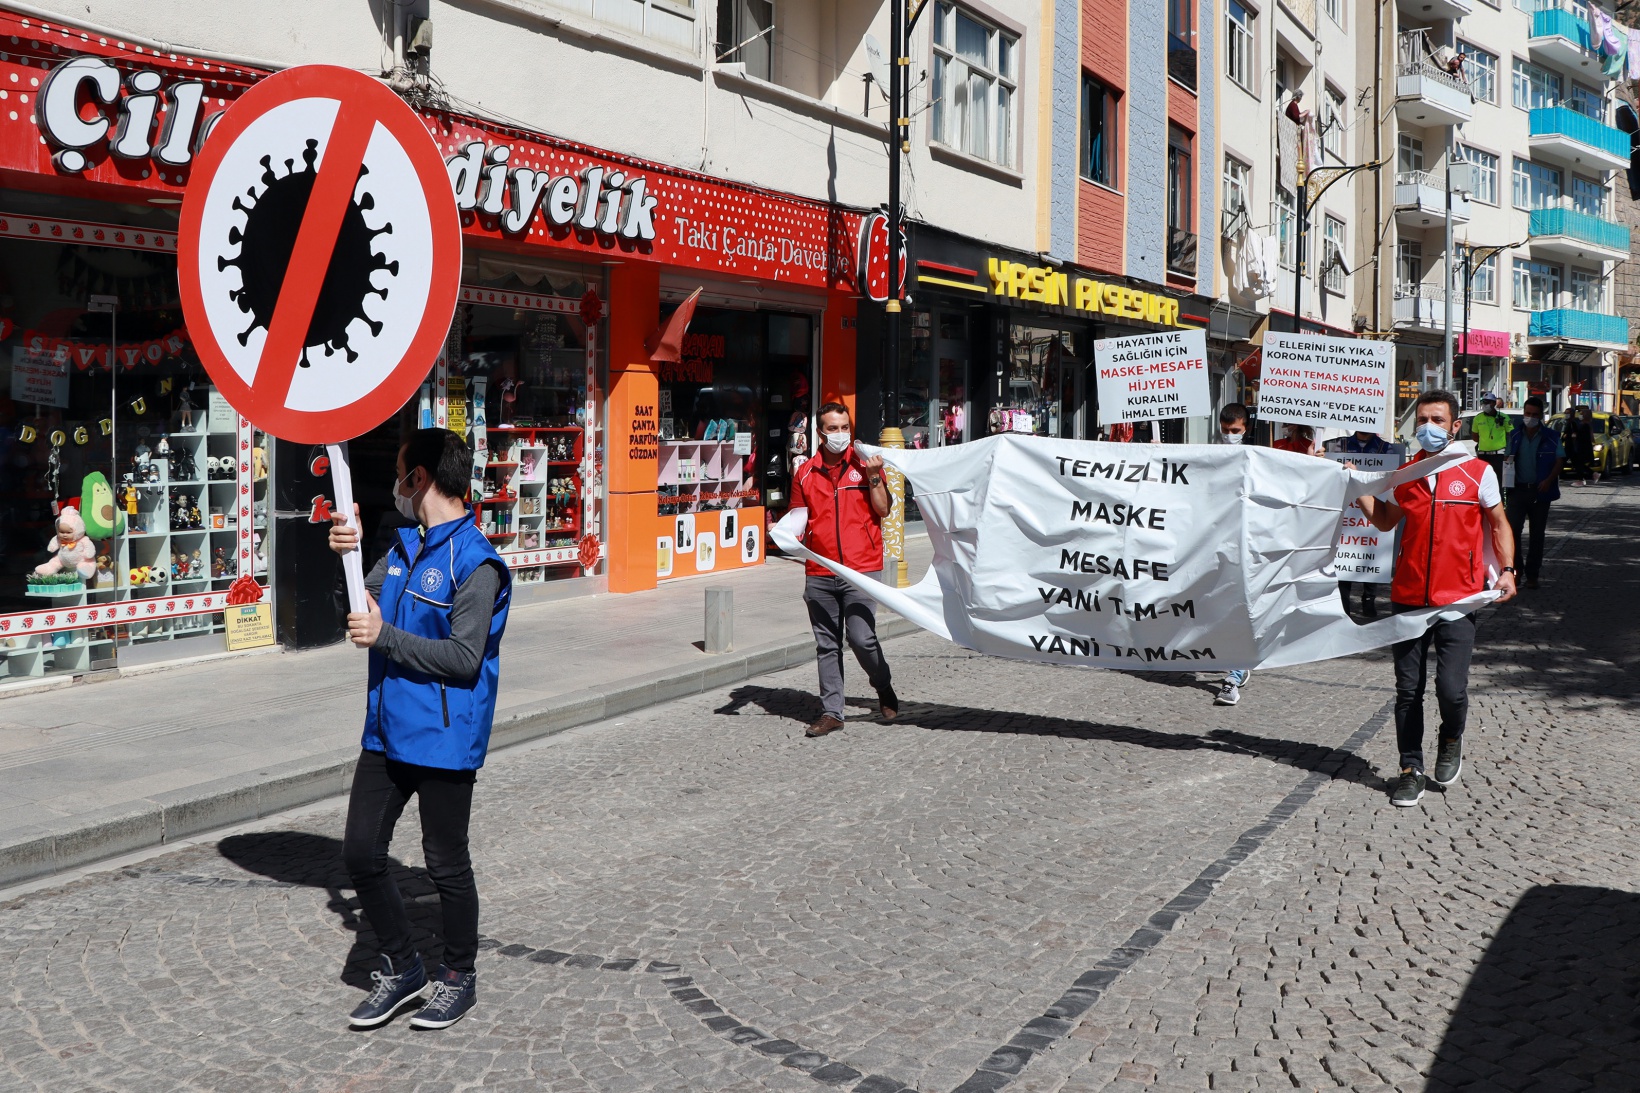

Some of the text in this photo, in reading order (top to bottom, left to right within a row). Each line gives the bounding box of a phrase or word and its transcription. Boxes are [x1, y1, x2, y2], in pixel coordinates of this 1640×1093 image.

[36, 55, 658, 240] Çil diyelik
[723, 226, 775, 262] Çanta
[988, 257, 1179, 327] YASİN AKSESUAR
[1116, 334, 1181, 349] HAYATIN VE
[1279, 340, 1374, 356] ELLERİNİ SIK YIKA
[1112, 346, 1188, 363] SAĞLIĞIN İÇİN
[1266, 350, 1386, 369] KORONA TUTUNMASIN
[1101, 359, 1203, 379] MASKE-MESAFE
[1269, 367, 1381, 386] YAKIN TEMAS KURMA
[1128, 378, 1176, 392] HİJYEN
[1263, 378, 1308, 390] KORONA
[1311, 382, 1385, 398] SIRNAŞMASIN
[1127, 393, 1179, 406] KURALINI
[1261, 394, 1321, 408] HASTAYSAN
[635, 405, 653, 416] SAAT
[1121, 406, 1187, 419] İHMAL ETME
[1260, 406, 1376, 425] KORONA ESİR ALMASIN
[632, 419, 656, 433] ÇANTA
[629, 432, 658, 445] PARFÜM
[629, 446, 658, 460] CÜZDAN
[1364, 457, 1383, 467] İÇİN
[1055, 456, 1189, 485] TEMİZLİK
[1070, 500, 1167, 531] MASKE
[1340, 533, 1378, 546] İJYEN
[1059, 548, 1169, 582] MESAFE
[1355, 566, 1380, 574] ETME
[1038, 587, 1101, 612] YANİ
[236, 615, 261, 624] DİKKAT
[1028, 635, 1216, 662] YANİ TAMAM
